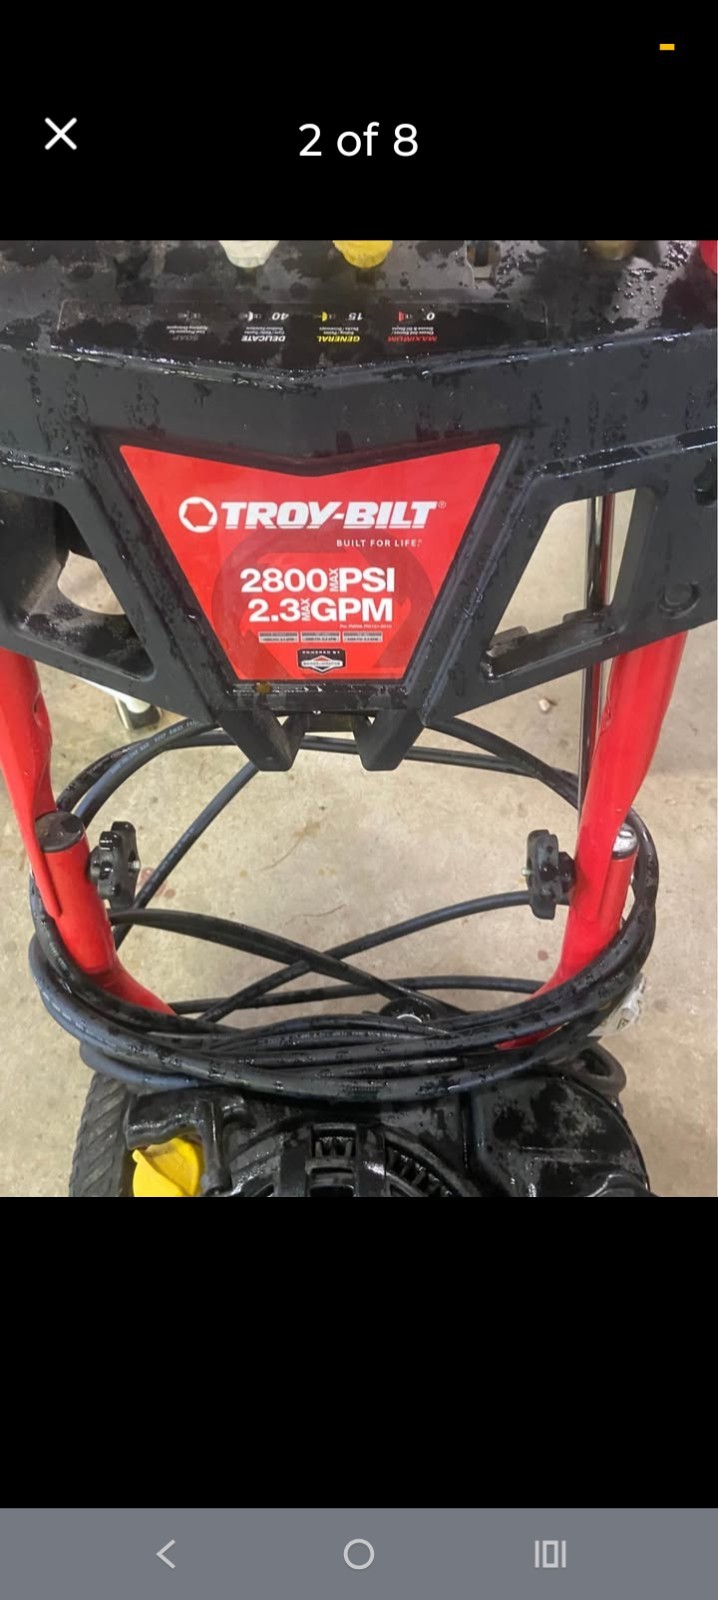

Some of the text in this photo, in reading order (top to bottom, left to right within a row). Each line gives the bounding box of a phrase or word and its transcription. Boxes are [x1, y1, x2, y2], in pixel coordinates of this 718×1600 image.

[299, 121, 418, 157] 2 of 8
[317, 335, 361, 343] GENERAL
[336, 539, 366, 547] BUILT
[370, 539, 391, 547] FOR
[240, 567, 395, 593] 2800 MAX PSI
[248, 597, 393, 622] 2.3 MAX GPM
